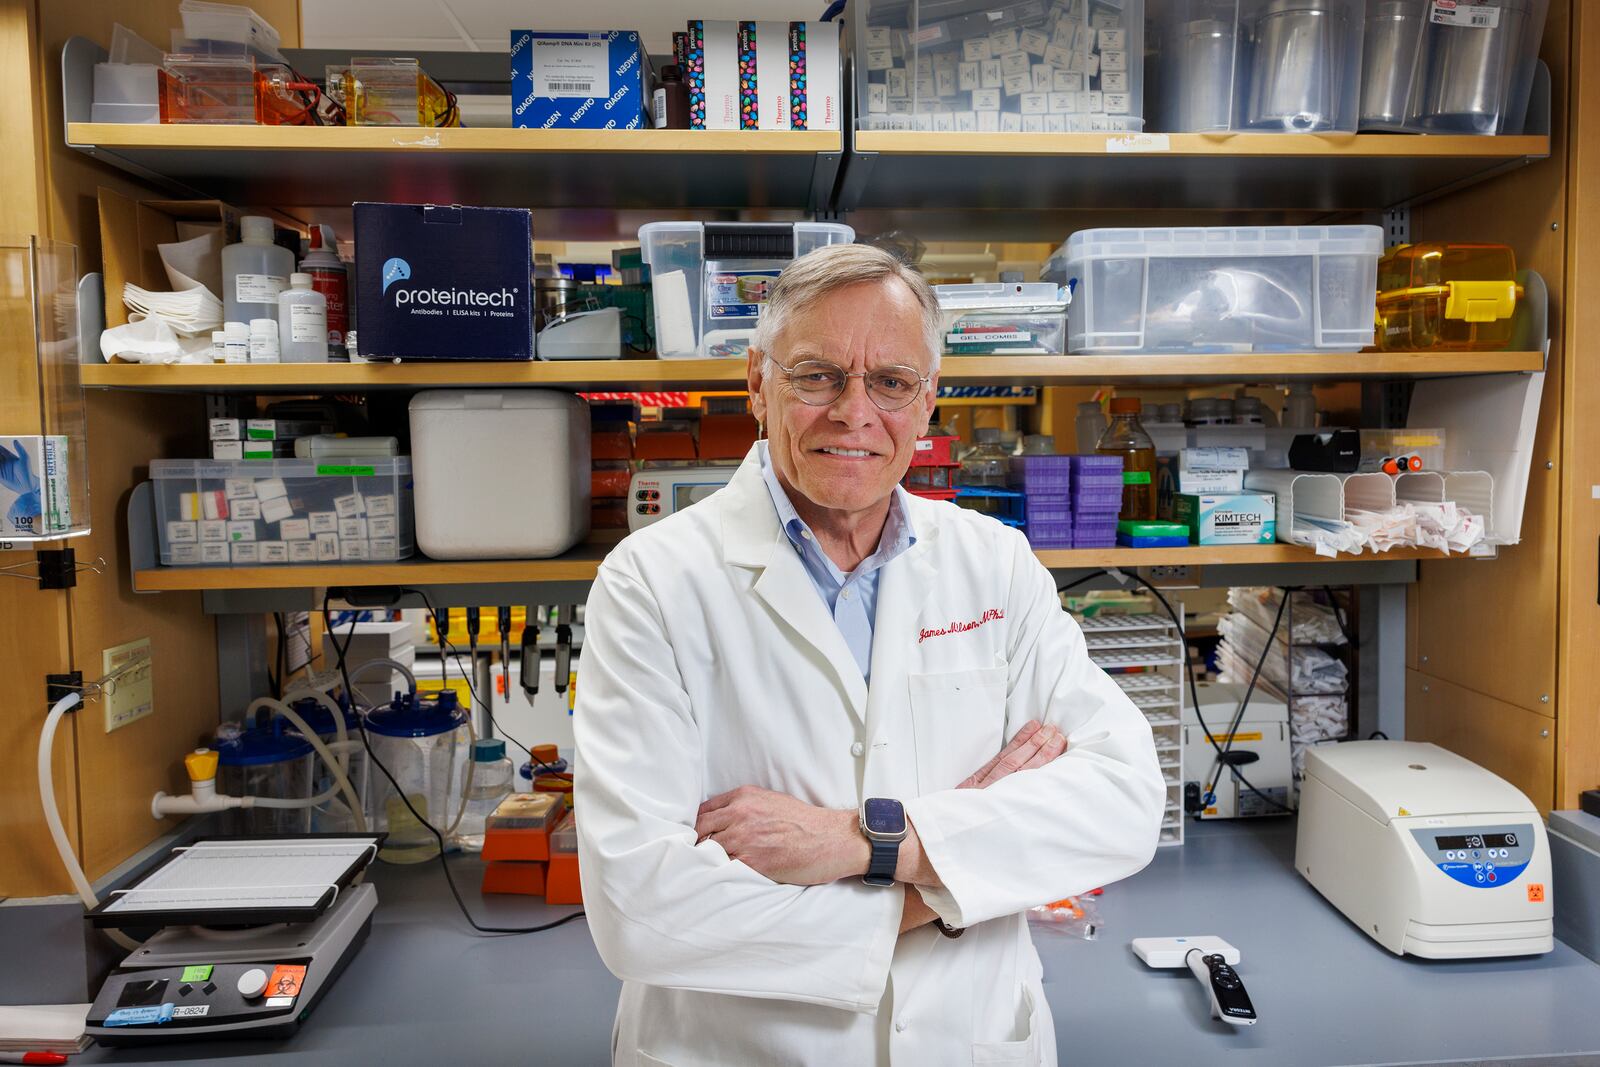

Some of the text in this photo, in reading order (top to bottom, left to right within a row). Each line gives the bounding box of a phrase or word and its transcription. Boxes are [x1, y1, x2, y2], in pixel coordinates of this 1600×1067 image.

[604, 84, 630, 111] QIAGEN
[569, 97, 595, 124] QIAGEN
[411, 308, 443, 316] Antibodies
[15, 516, 33, 525] 100
[1214, 513, 1261, 521] KIMTECH
[918, 628, 946, 643] James
